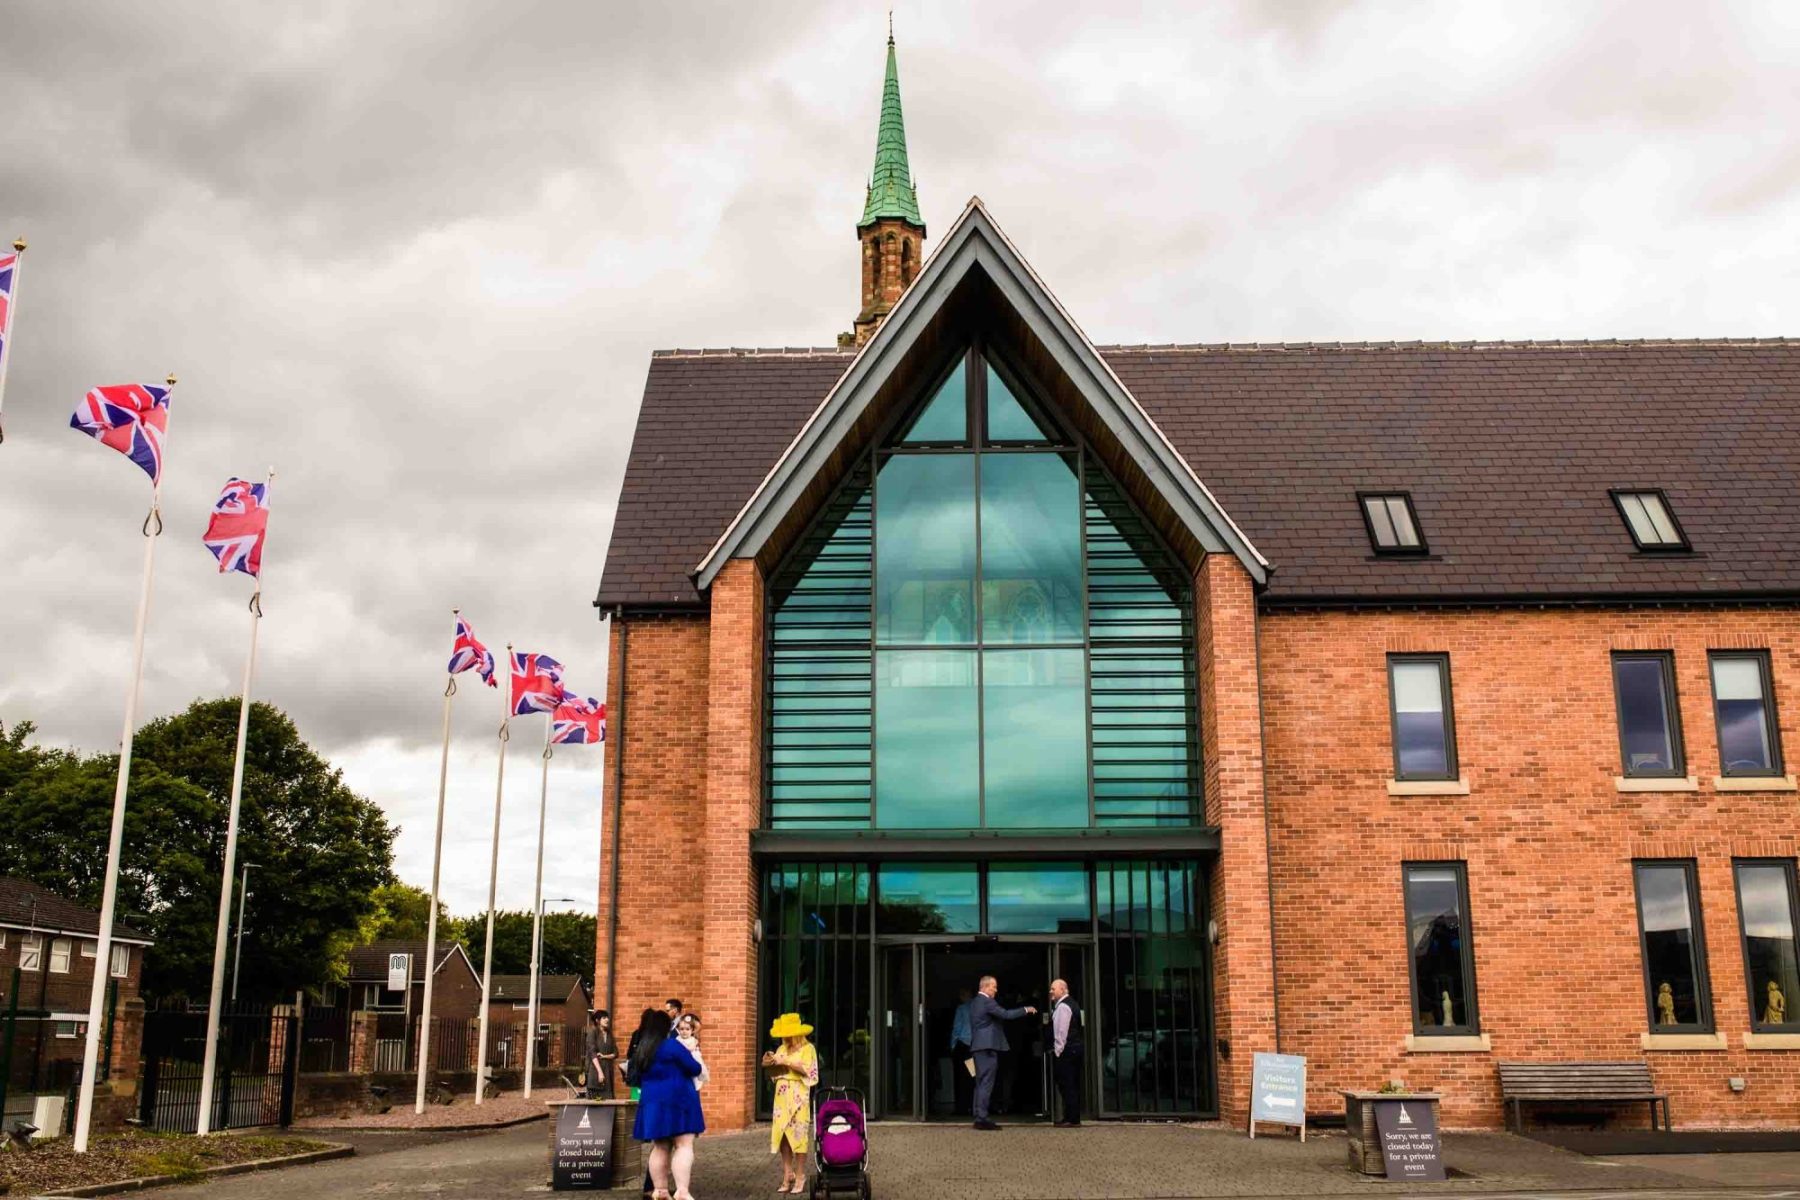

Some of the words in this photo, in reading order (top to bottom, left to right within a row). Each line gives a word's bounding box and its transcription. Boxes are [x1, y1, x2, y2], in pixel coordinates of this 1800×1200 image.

[1385, 1132, 1407, 1142] Sorry,
[1387, 1142, 1411, 1150] closed
[1412, 1142, 1434, 1152] today
[559, 1148, 582, 1157] closed
[584, 1148, 605, 1158] today
[1389, 1152, 1401, 1160] for
[1409, 1152, 1436, 1162] private
[559, 1159, 571, 1168] for
[578, 1160, 605, 1169] private
